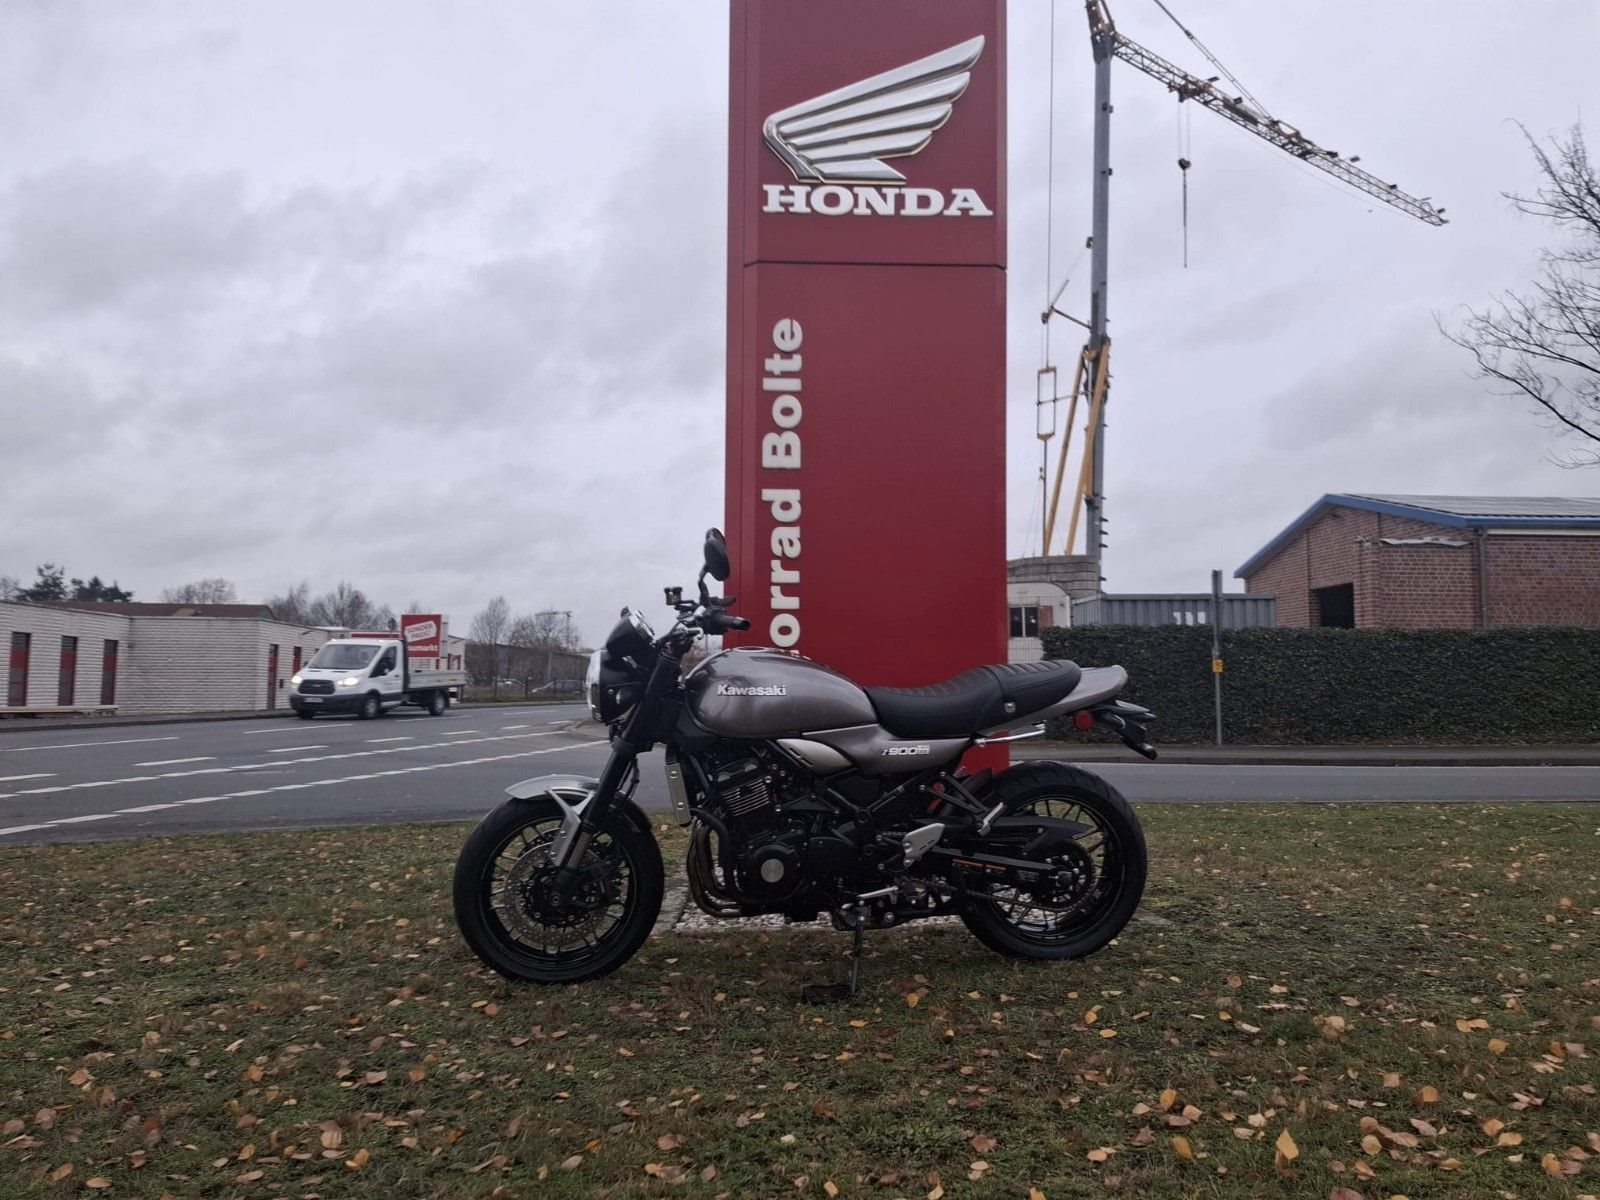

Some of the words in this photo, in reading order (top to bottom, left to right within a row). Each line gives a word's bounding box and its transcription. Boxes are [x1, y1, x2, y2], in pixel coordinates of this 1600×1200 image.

[762, 184, 994, 217] HONDA
[761, 317, 804, 470] Bolte
[761, 488, 803, 650] orrad
[716, 683, 788, 697] Kawasaki
